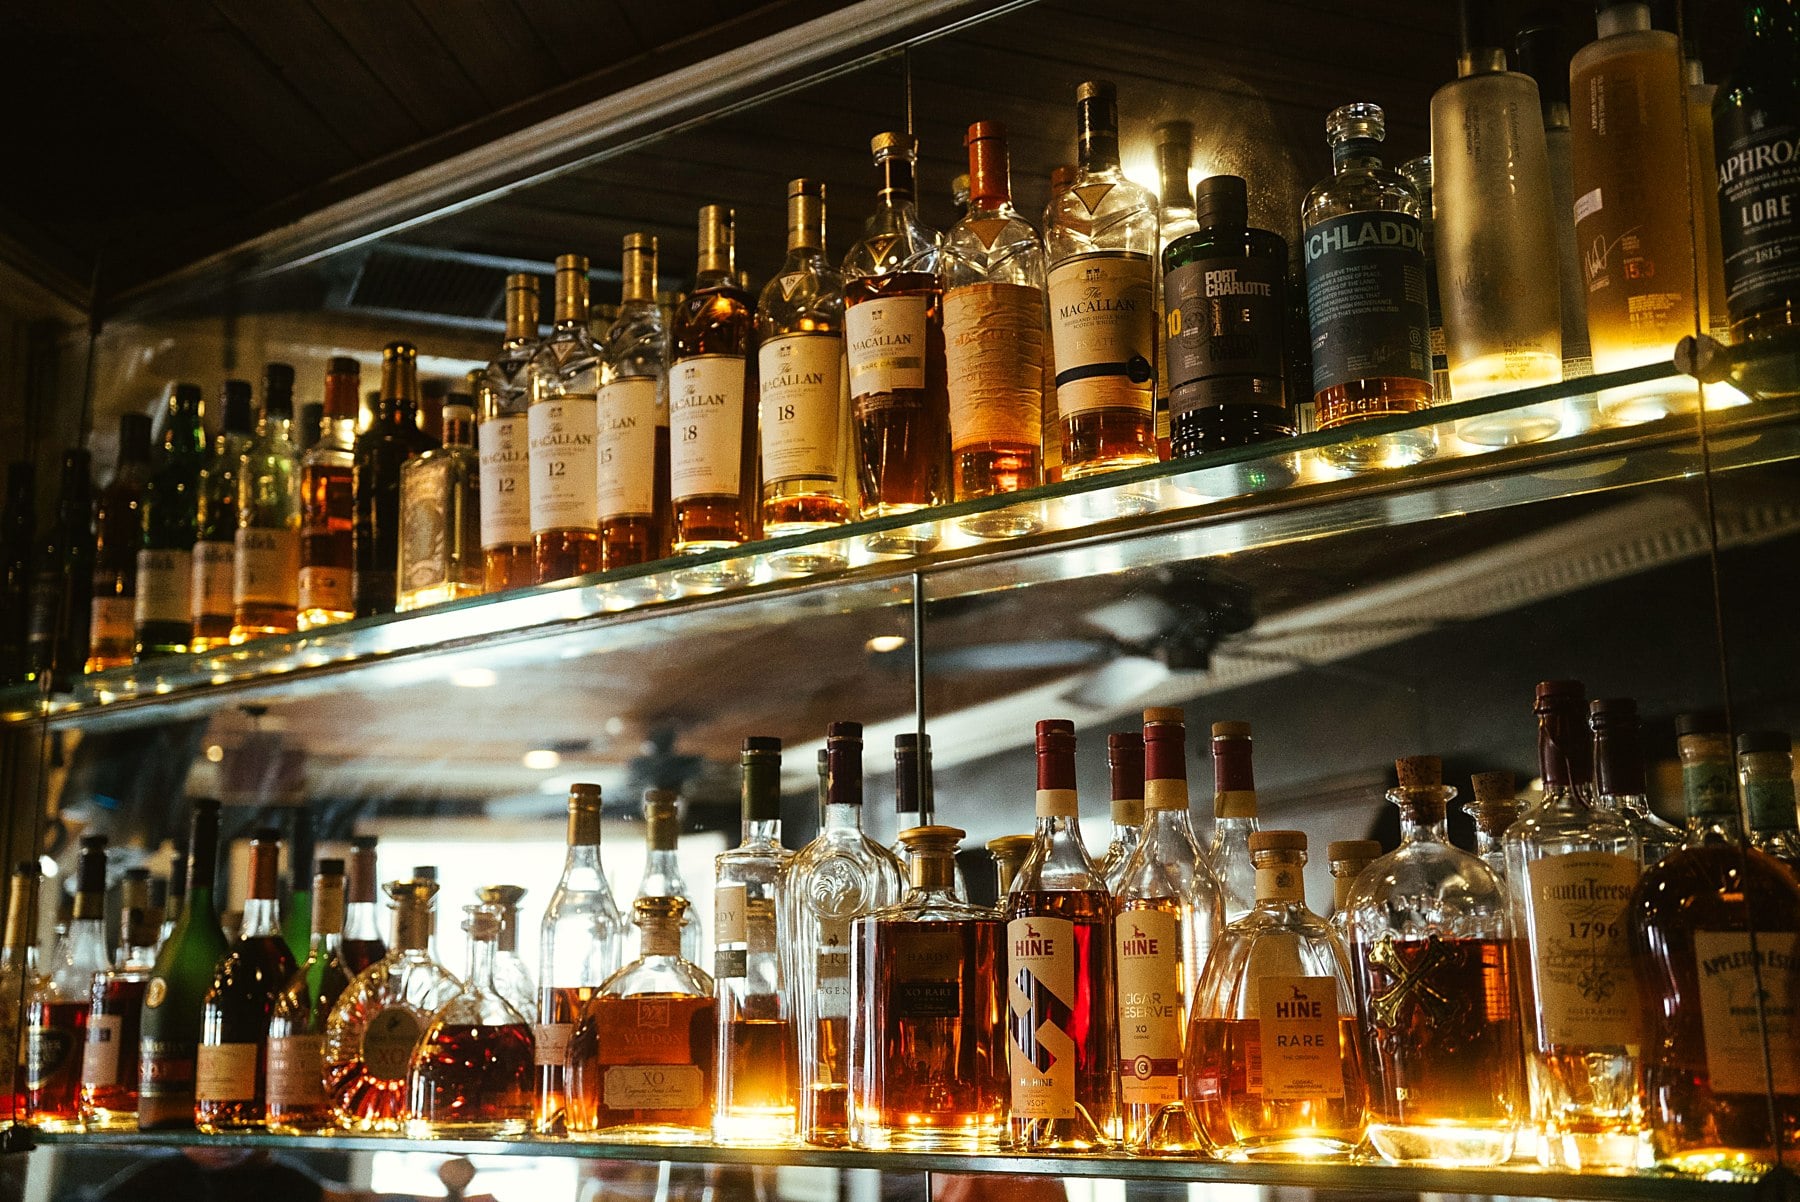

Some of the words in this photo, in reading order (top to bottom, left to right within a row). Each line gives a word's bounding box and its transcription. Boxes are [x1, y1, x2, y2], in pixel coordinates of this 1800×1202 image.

[1717, 138, 1800, 193] APHRO
[1741, 195, 1792, 228] LORE
[1755, 245, 1782, 264] 1815
[785, 276, 796, 286] 18
[1204, 269, 1238, 285] PORT
[1082, 286, 1103, 301] The
[1205, 281, 1271, 298] CHARLOTTE
[1059, 298, 1137, 321] MACALLAN
[1166, 308, 1183, 340] 10
[852, 333, 912, 351] MACALLAN
[778, 404, 795, 421] 18
[683, 426, 697, 442] 18
[601, 448, 613, 464] 15
[548, 459, 566, 477] 12
[498, 477, 515, 493] 12
[1568, 922, 1619, 939] 1796
[1015, 939, 1054, 957] HINE
[1123, 938, 1158, 957] HINE
[905, 952, 949, 962] HARDY
[904, 987, 921, 997] XO
[924, 987, 952, 997] RARE
[1124, 992, 1162, 1006] CIGAR
[1122, 1005, 1173, 1019] ESERVE
[1275, 1001, 1323, 1019] HINE
[1135, 1024, 1149, 1034] XO
[1277, 1034, 1325, 1048] RARE
[642, 1071, 665, 1088] XO
[1020, 1077, 1026, 1088] H
[1032, 1077, 1054, 1088] HINE
[1026, 1099, 1046, 1107] VSOP
